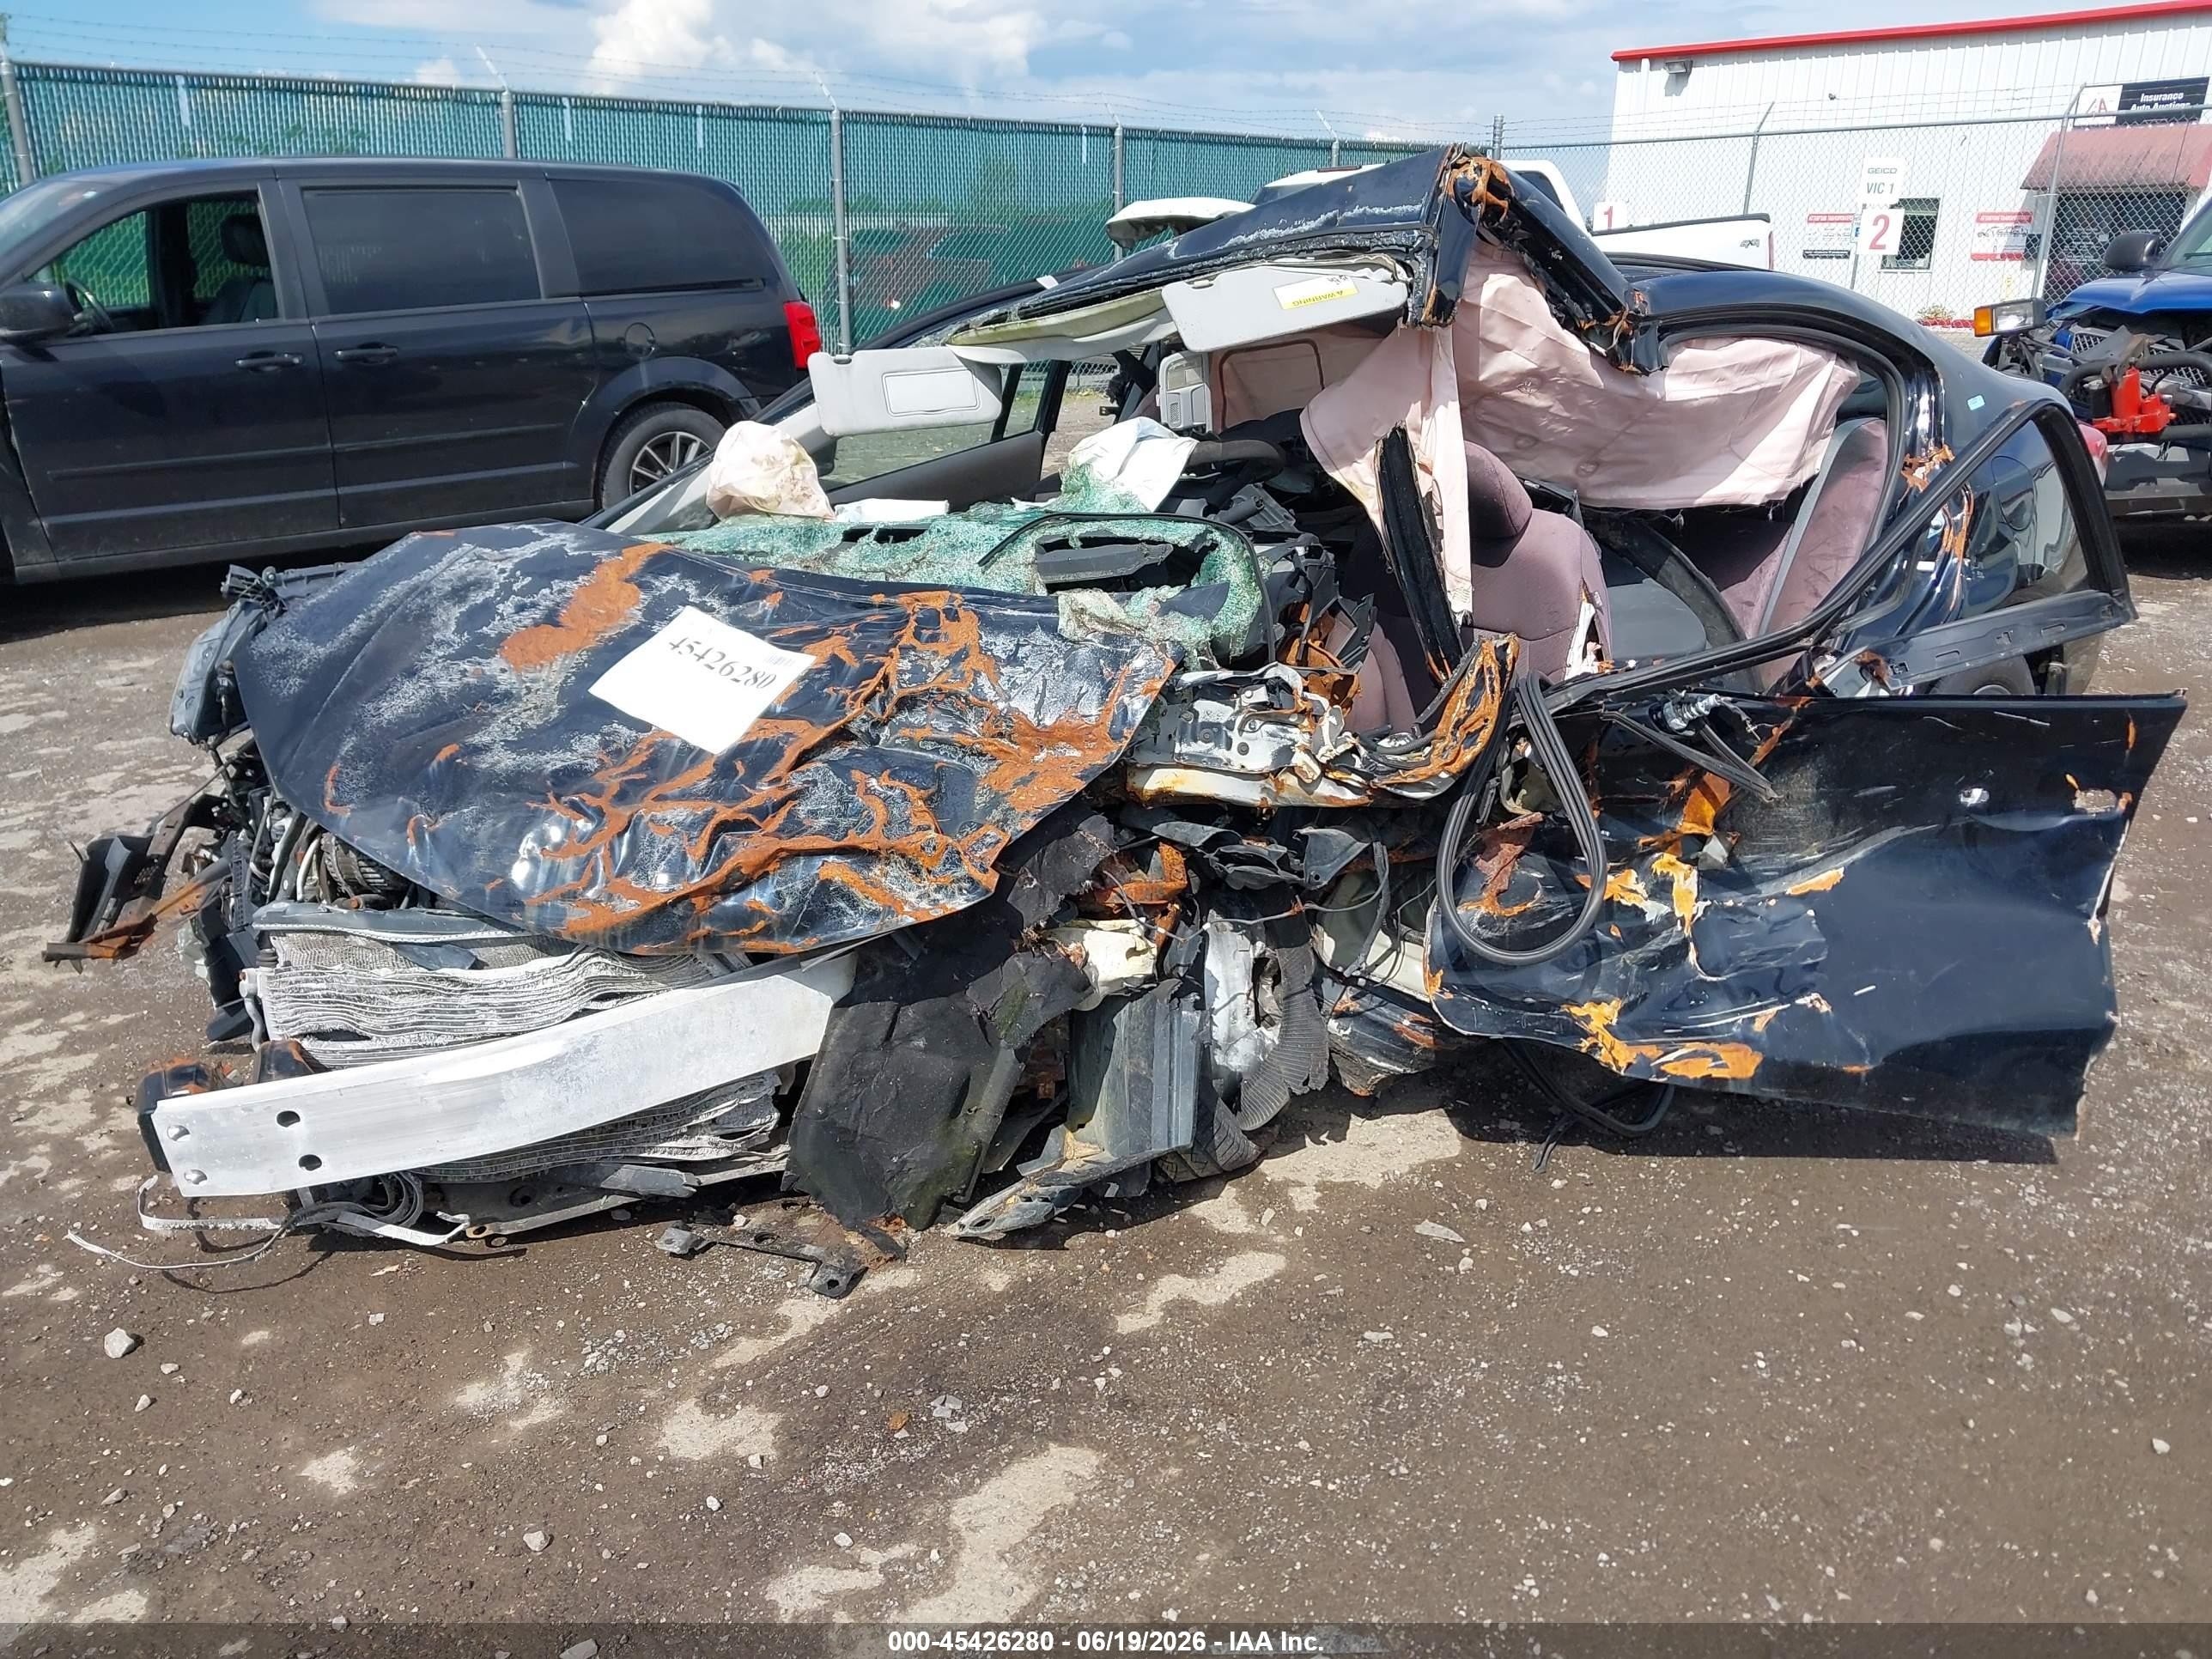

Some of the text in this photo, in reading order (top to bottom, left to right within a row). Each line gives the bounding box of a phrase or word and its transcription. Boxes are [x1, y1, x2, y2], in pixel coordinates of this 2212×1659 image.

[2140, 92, 2185, 102] Insurance
[1867, 182, 1895, 194] VIC 1
[1603, 205, 1613, 230] 1
[1869, 214, 1891, 250] 2
[1292, 292, 1335, 307] WARNING
[668, 636, 777, 690] 45426280
